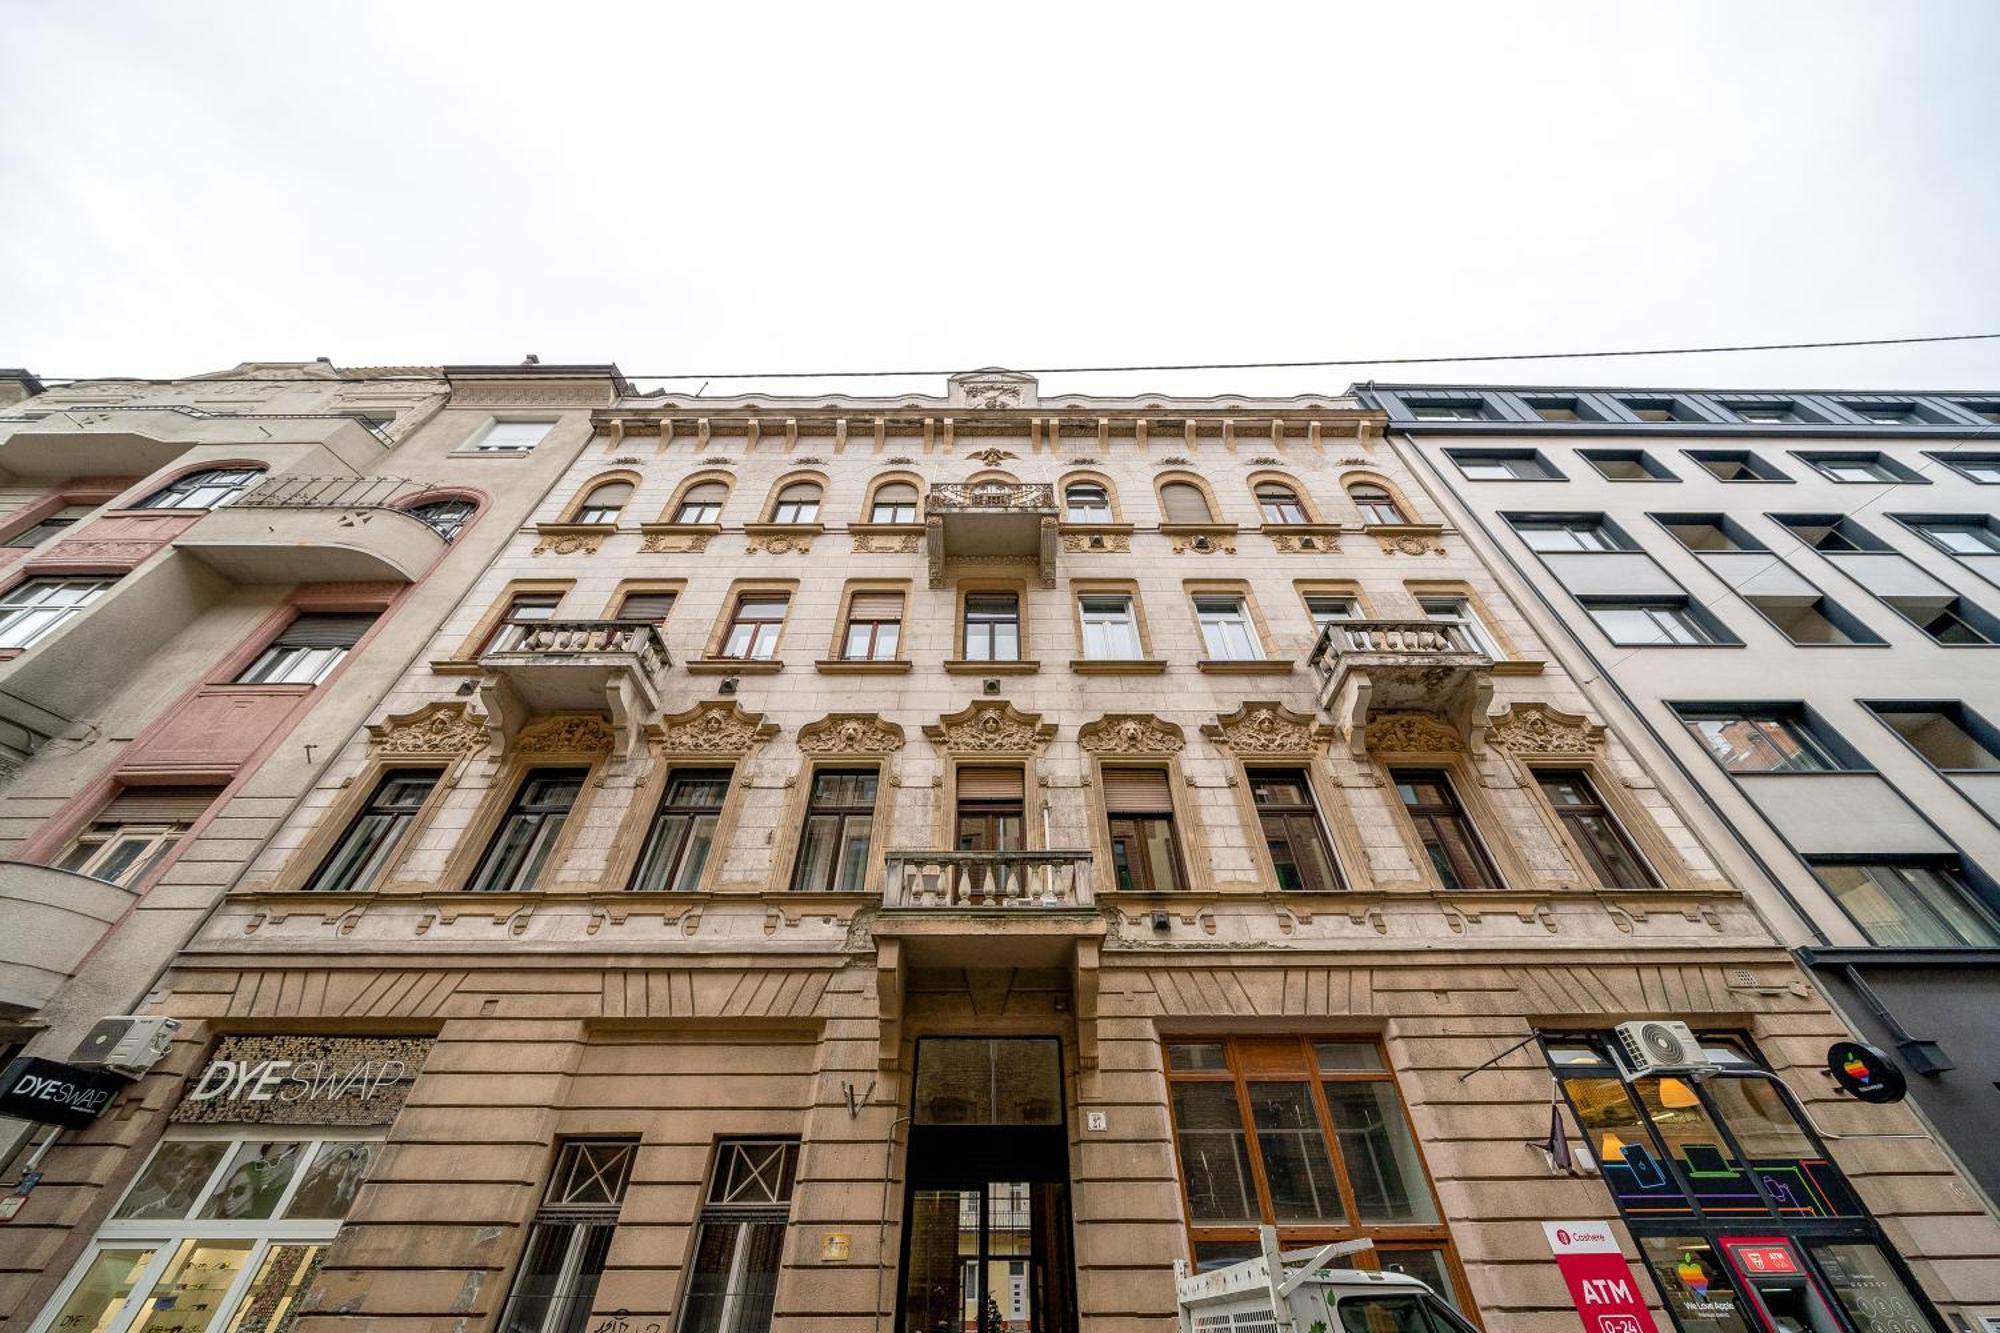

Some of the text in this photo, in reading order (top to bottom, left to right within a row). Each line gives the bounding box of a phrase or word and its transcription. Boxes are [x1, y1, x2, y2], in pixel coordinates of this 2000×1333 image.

[12, 1074, 108, 1108] DYESWAP
[190, 1060, 405, 1101] DYESWAP
[1582, 1279, 1635, 1305] ATM
[1605, 1320, 1638, 1333] 0-24
